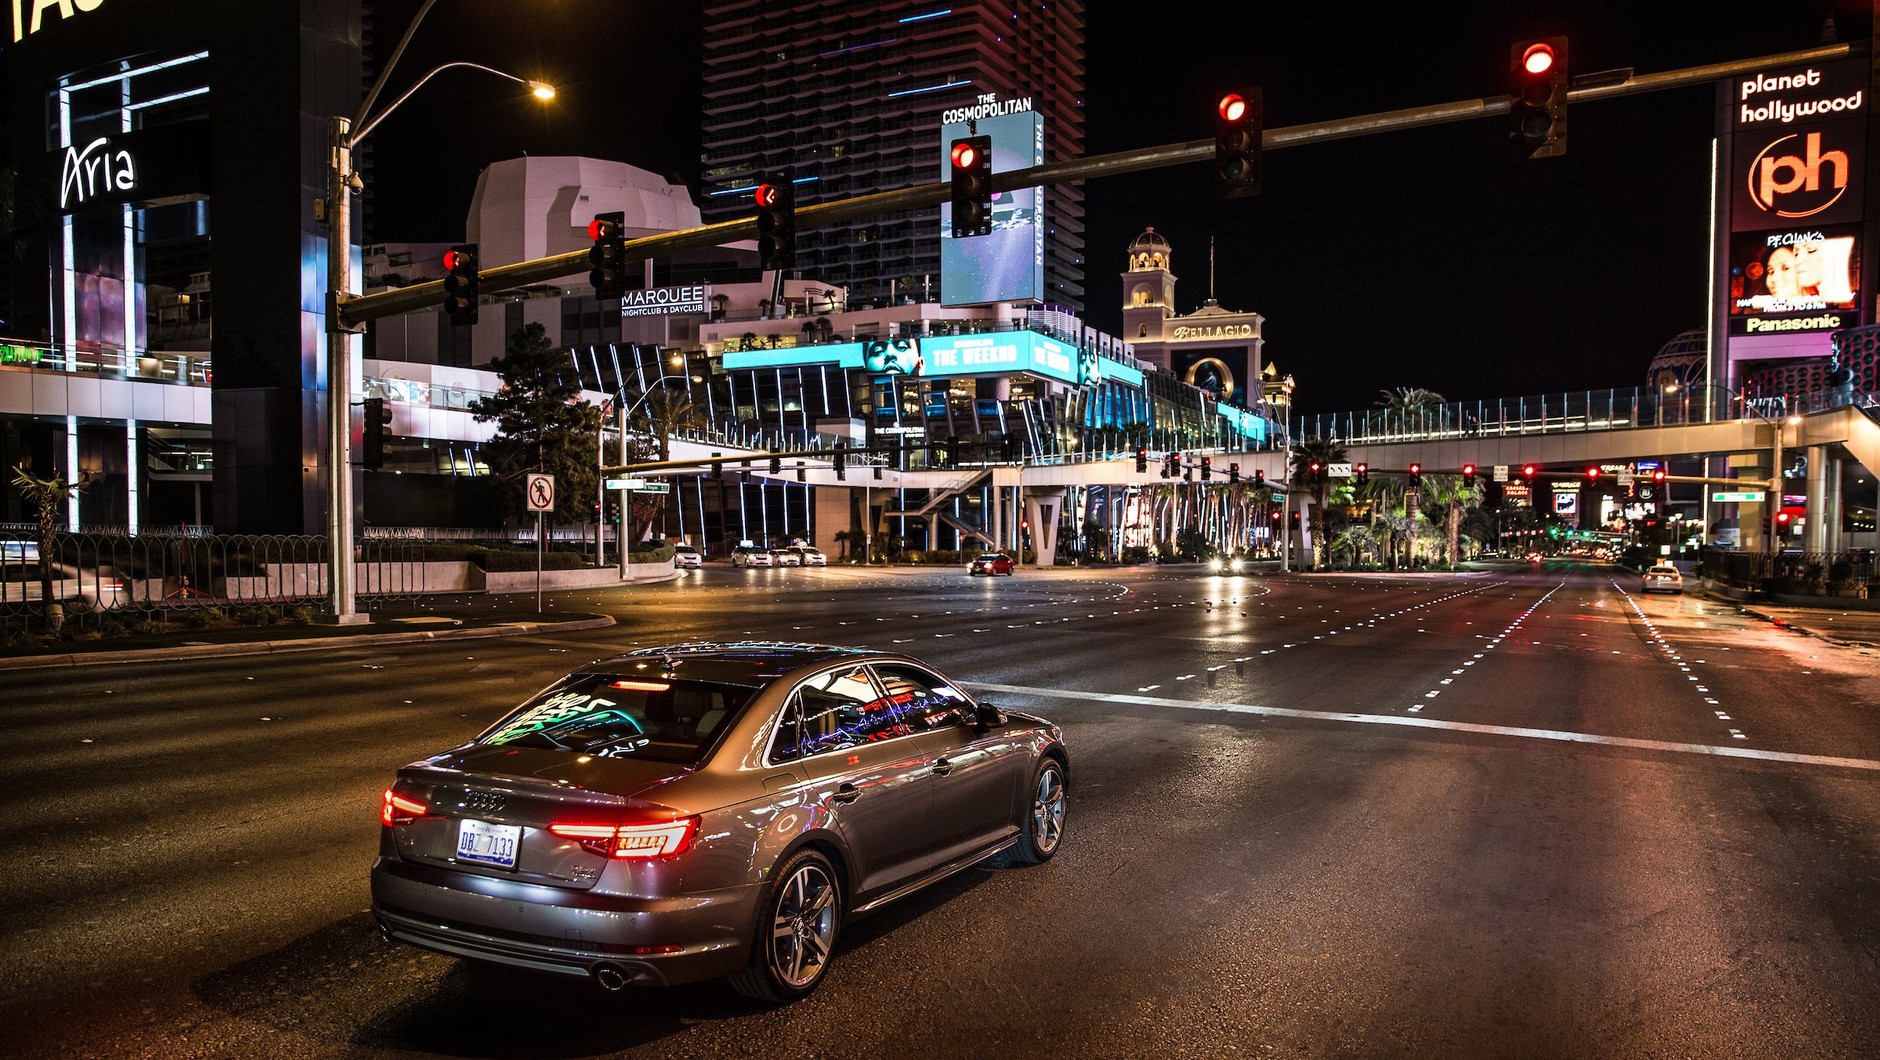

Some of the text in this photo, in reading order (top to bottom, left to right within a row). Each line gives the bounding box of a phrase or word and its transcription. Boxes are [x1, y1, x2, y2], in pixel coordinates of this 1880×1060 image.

[1741, 68, 1821, 100] planet
[977, 92, 996, 104] THE
[1741, 90, 1862, 123] hollywood
[942, 96, 1032, 125] COSMOPOLITAN
[61, 137, 134, 209] Aria
[621, 286, 703, 306] MARQUEE
[621, 307, 662, 317] NIGHTCLUB
[670, 304, 703, 314] DAYCLUB
[1173, 324, 1252, 339] BELLAGIO
[1746, 314, 1841, 332] Panasonic
[933, 349, 958, 367] THE
[461, 831, 513, 857] DBZ 7133
